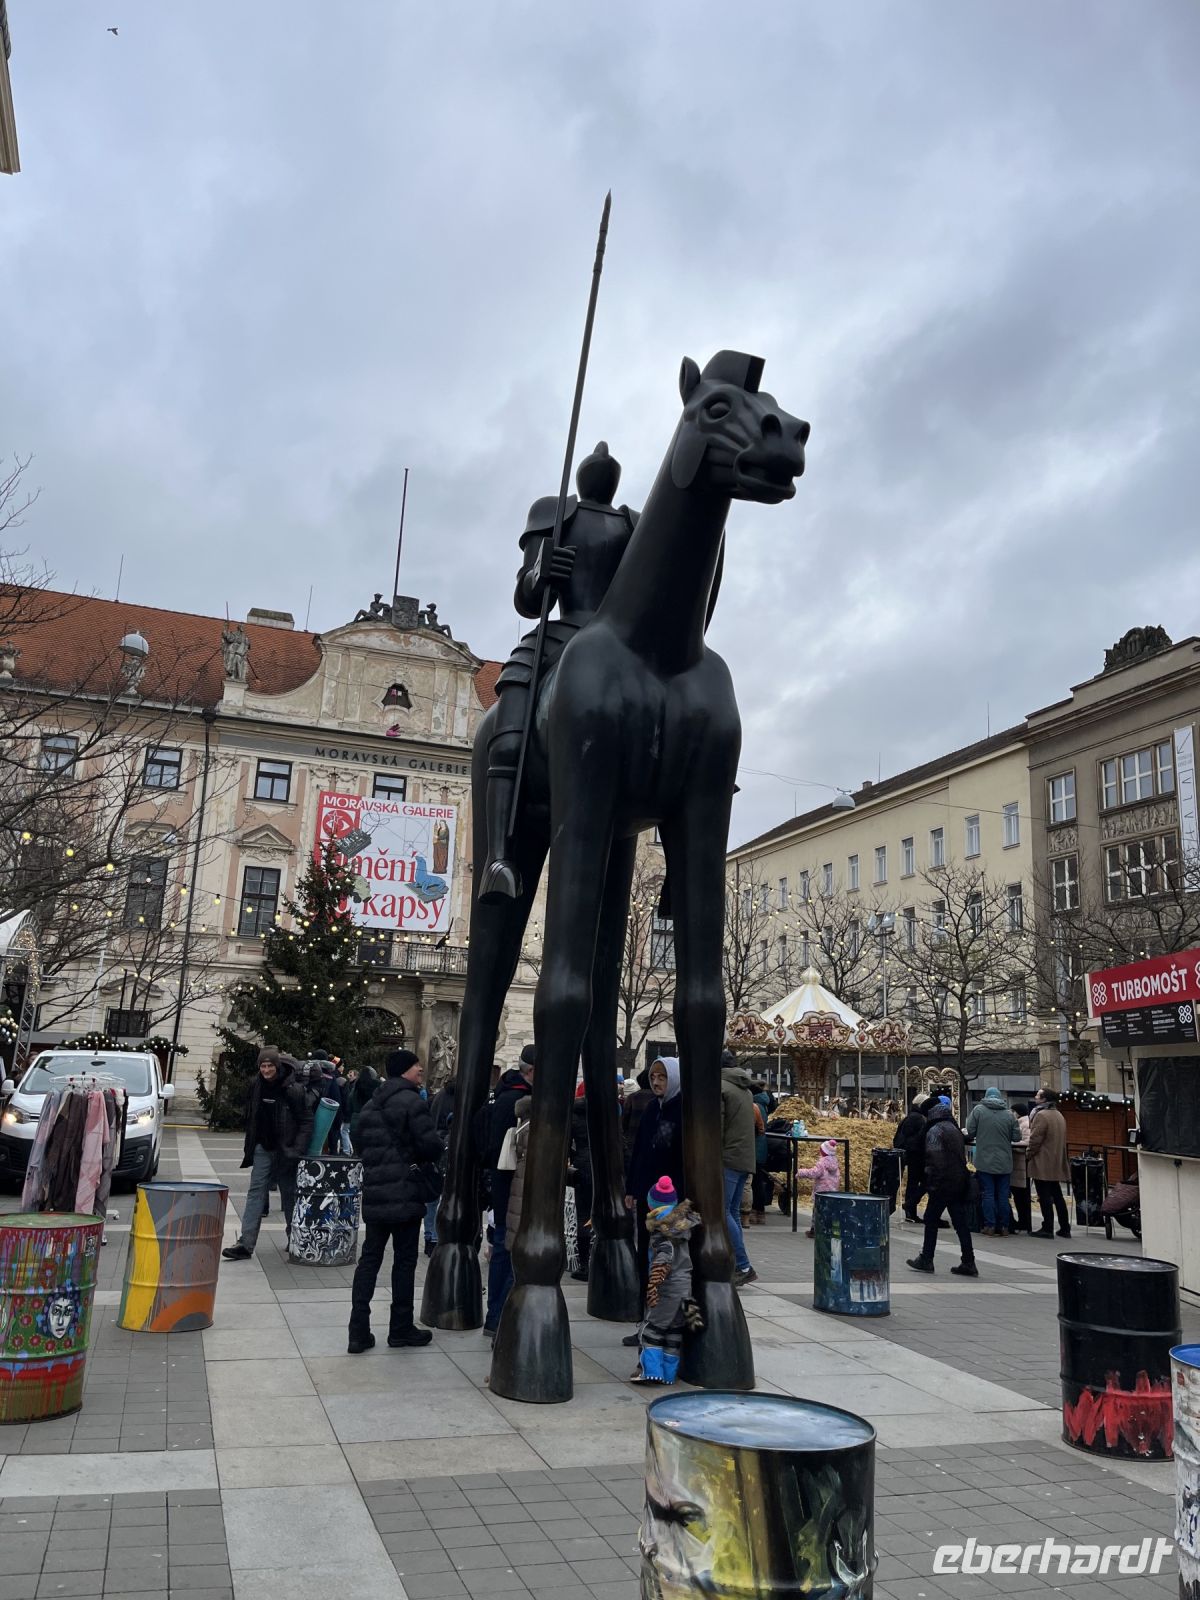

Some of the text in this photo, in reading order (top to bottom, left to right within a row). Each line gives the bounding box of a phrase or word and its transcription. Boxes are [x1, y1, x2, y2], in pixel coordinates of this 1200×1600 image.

[315, 747, 468, 775] MORAVSKÁ GALERIE
[323, 795, 454, 819] MORAVSKÁ GALERIE
[1111, 963, 1188, 1003] TURBOMOŠT
